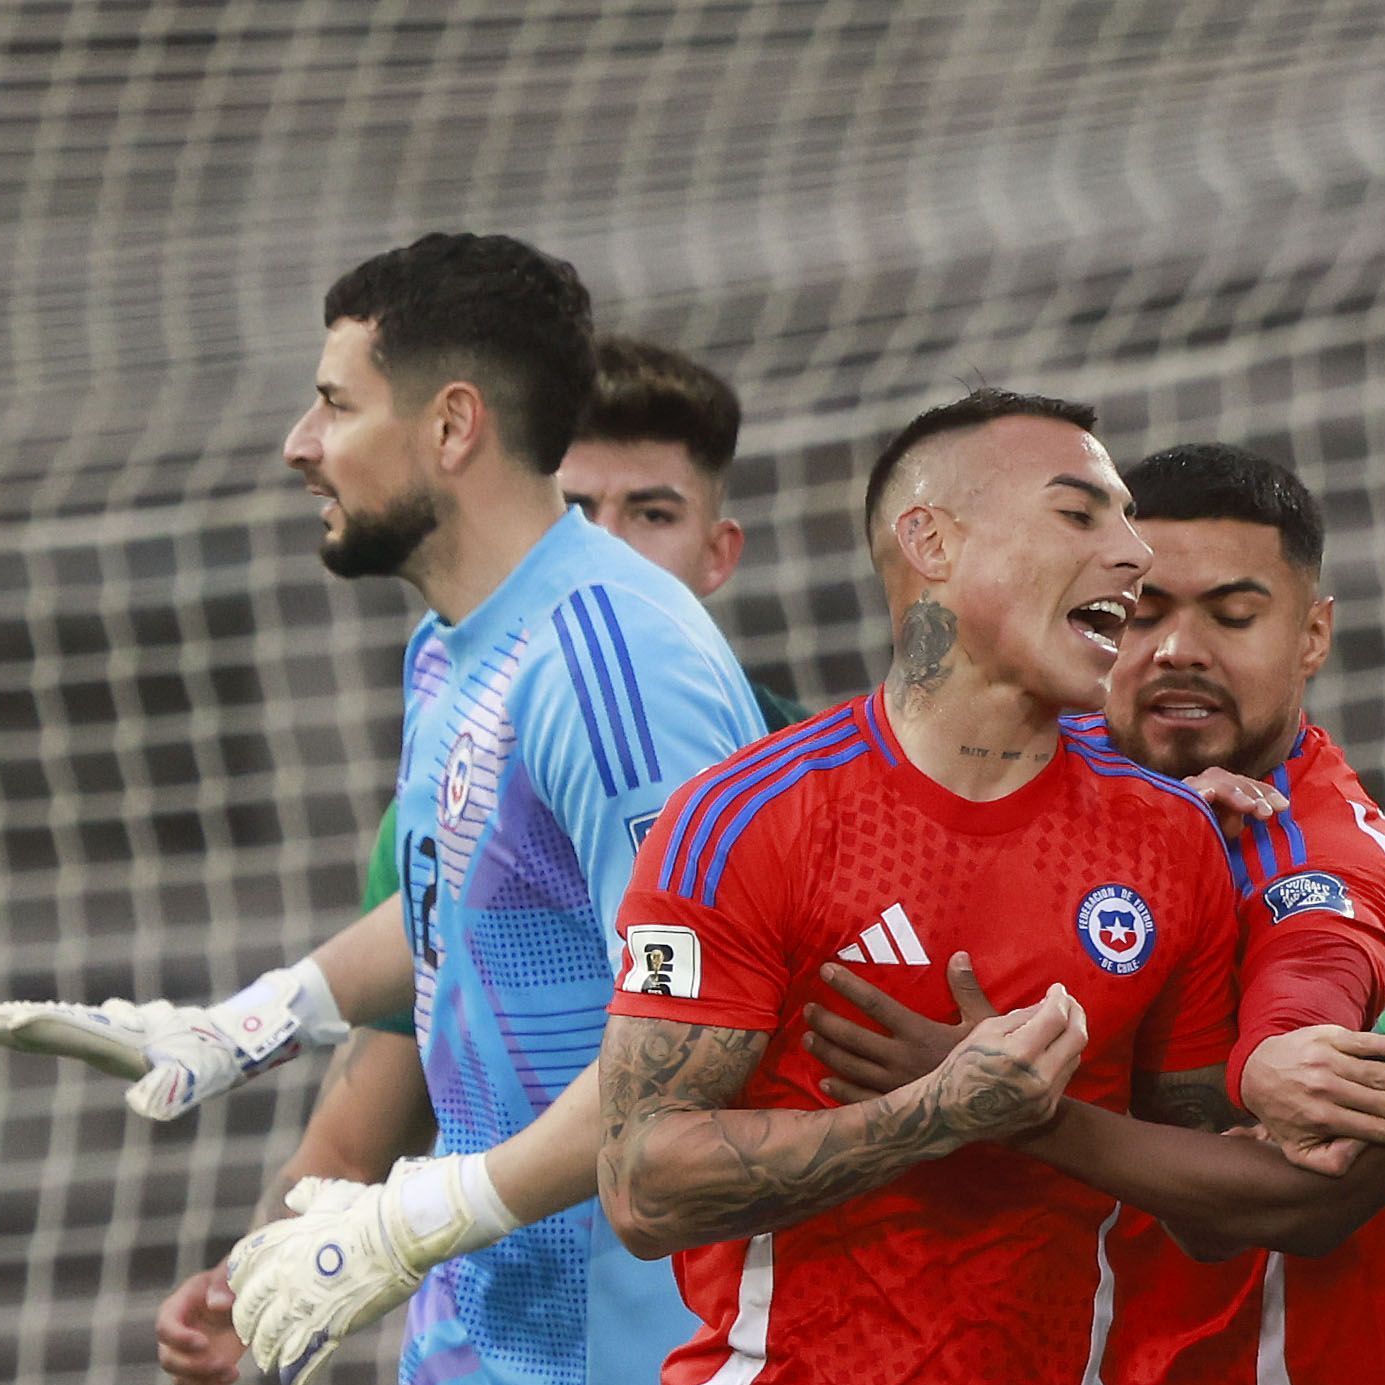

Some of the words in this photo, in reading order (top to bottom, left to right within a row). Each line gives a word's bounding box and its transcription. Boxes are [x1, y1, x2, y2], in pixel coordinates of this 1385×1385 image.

[1078, 887, 1116, 930] FEDERACION
[1120, 888, 1134, 901] DE
[1101, 959, 1114, 971] DE
